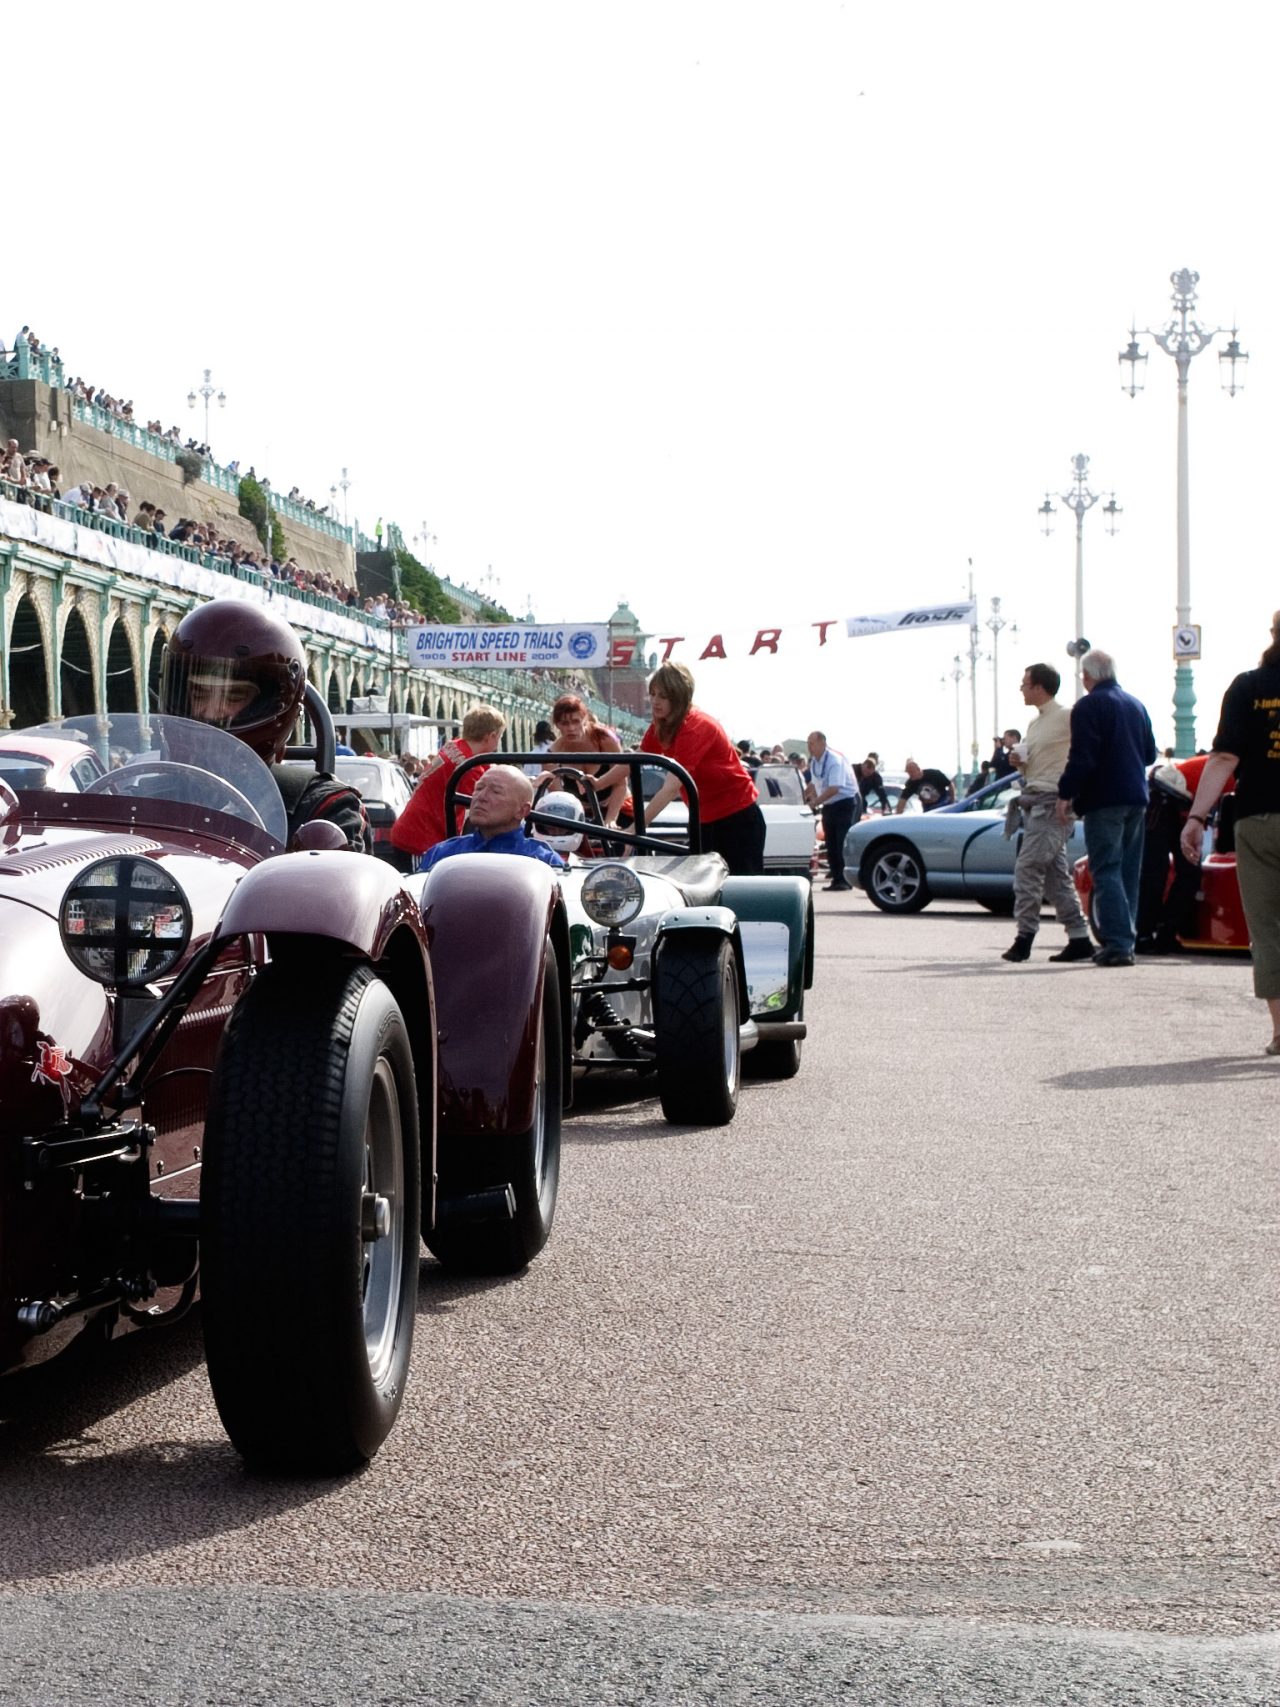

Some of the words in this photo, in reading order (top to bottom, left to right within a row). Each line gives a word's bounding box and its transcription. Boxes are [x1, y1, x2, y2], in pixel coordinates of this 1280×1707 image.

[416, 632, 478, 650] BRIGHTON
[480, 631, 520, 649] SPEED
[523, 631, 564, 650] TRIALS
[451, 652, 491, 662] START
[496, 652, 527, 662] LINE
